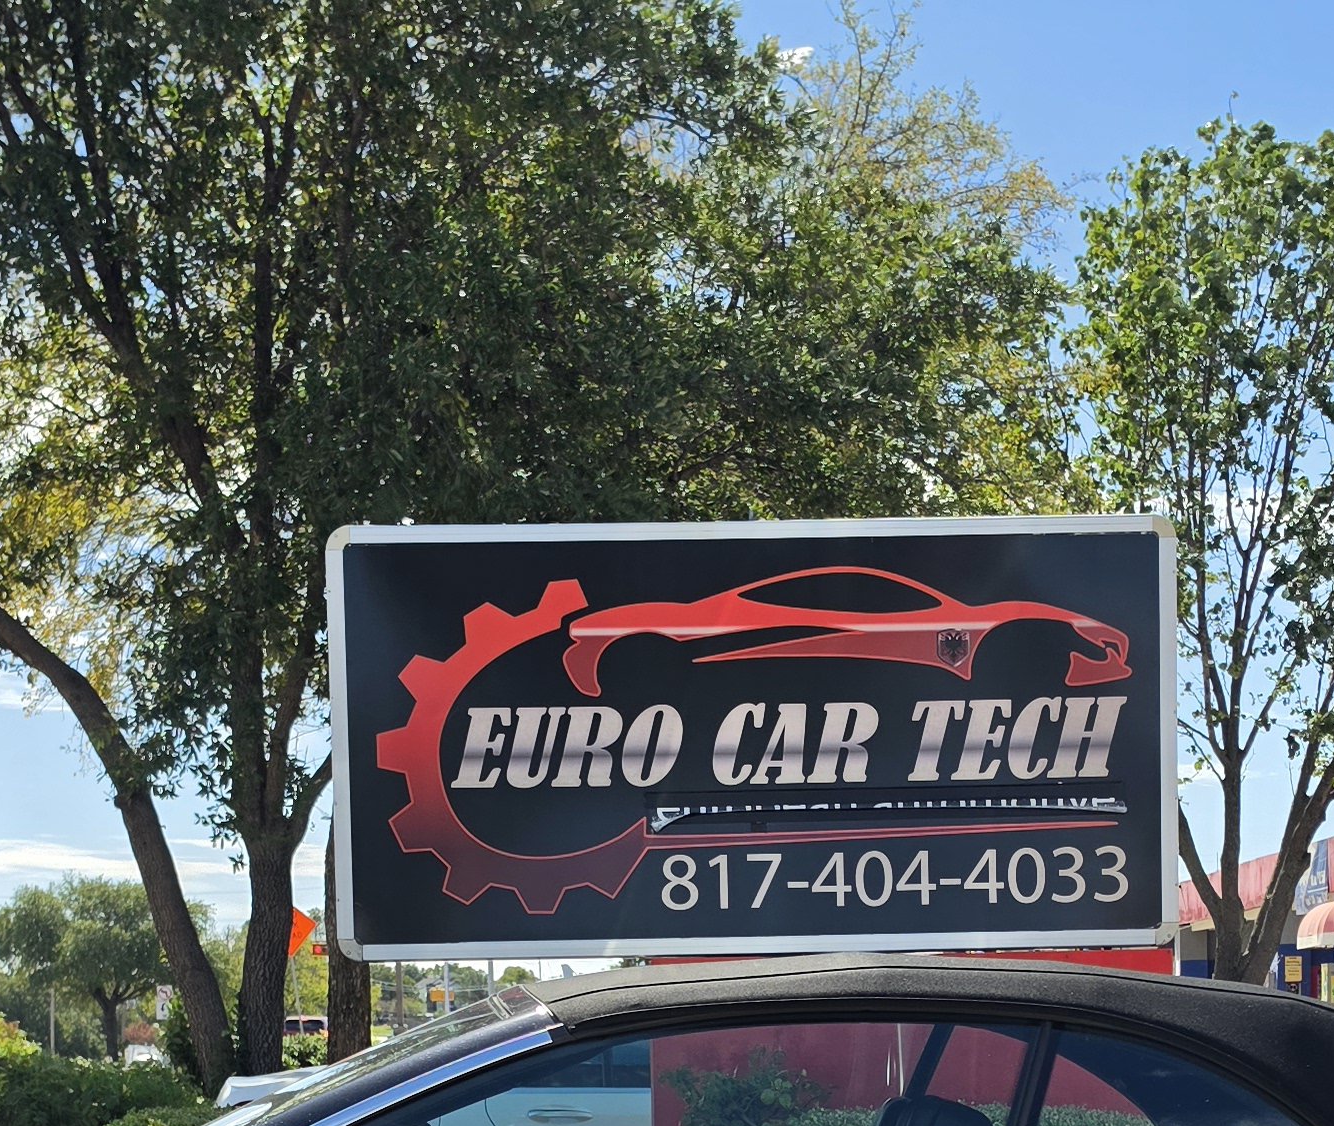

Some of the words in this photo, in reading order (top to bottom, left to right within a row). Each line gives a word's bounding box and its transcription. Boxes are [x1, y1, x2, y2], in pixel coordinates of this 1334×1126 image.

[450, 703, 684, 789] EURO
[713, 701, 878, 786] CAR
[908, 695, 1128, 783] TECH
[661, 845, 1129, 911] 817-404-4033
